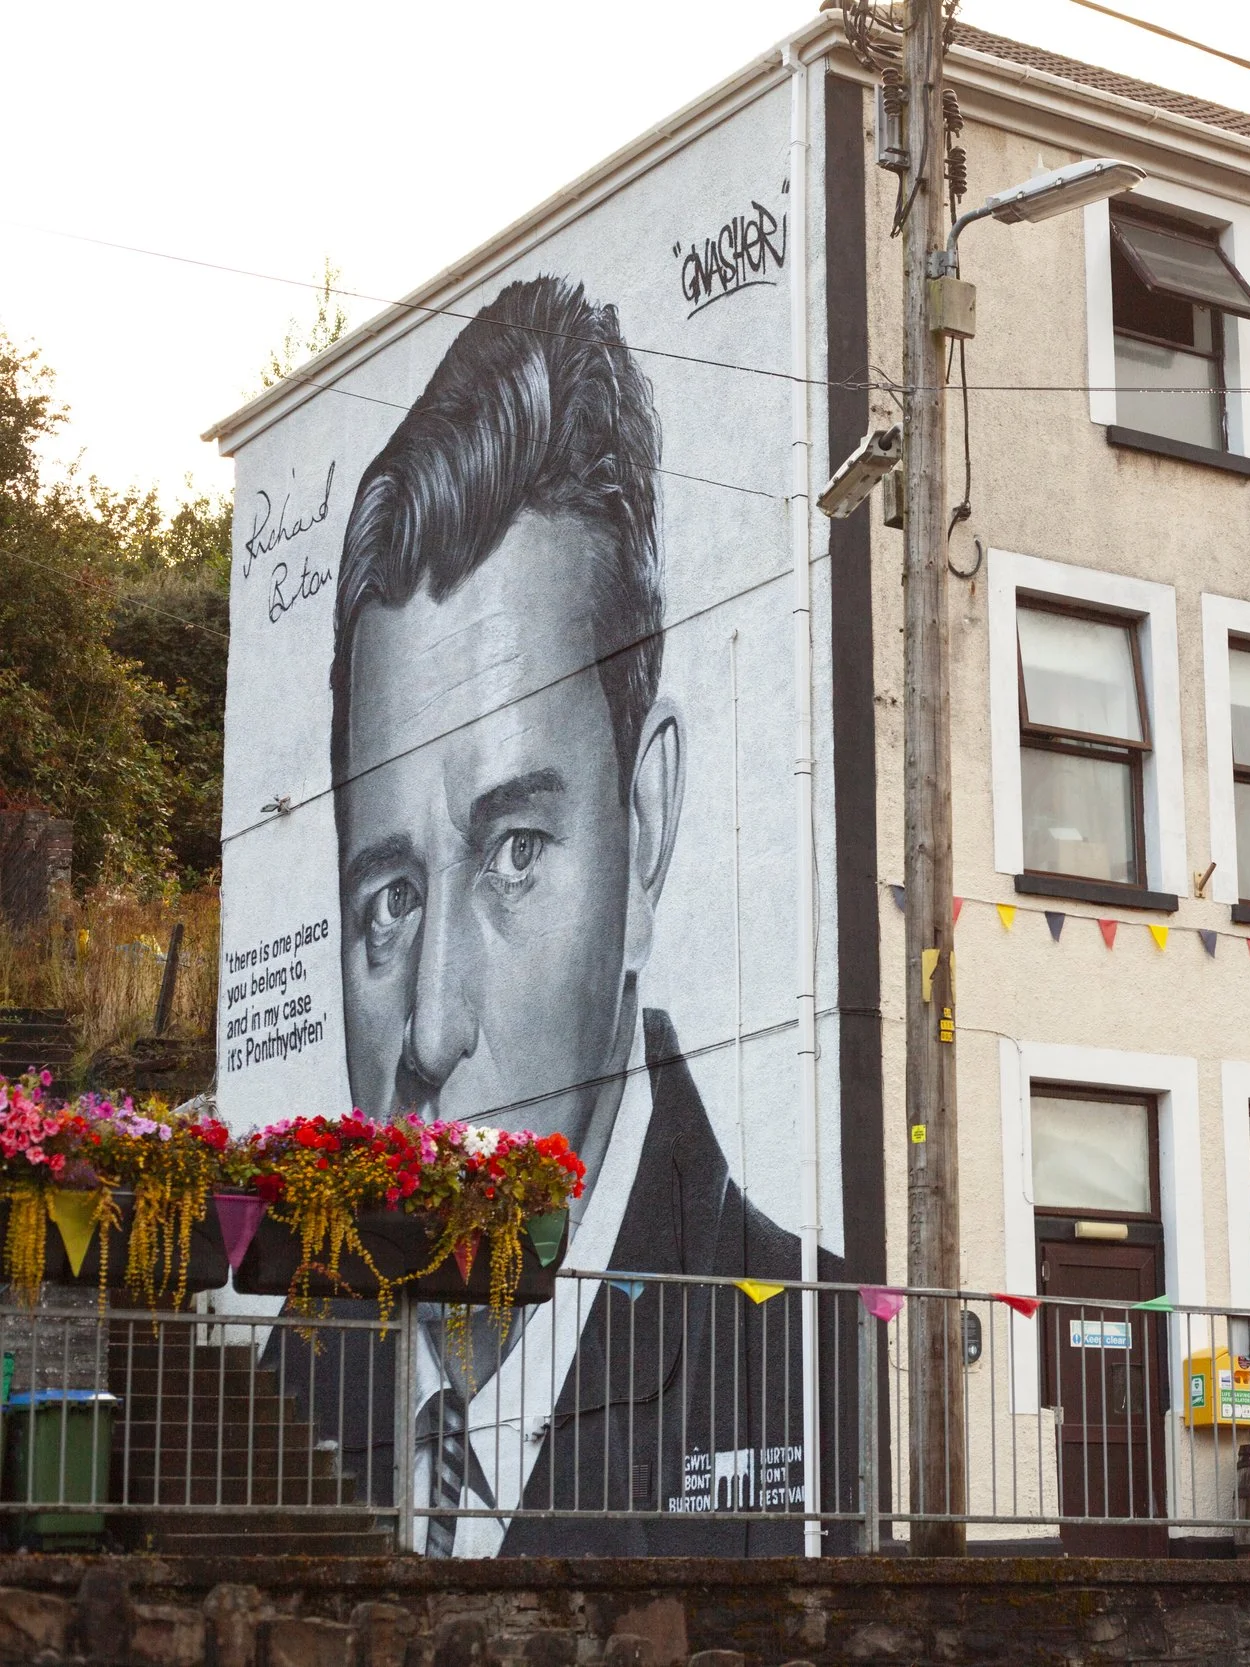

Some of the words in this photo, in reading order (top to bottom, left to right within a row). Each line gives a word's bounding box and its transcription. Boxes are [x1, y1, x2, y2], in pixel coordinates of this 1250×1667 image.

[259, 940, 270, 962] is
[272, 934, 292, 958] one
[294, 918, 329, 957] place
[227, 982, 247, 1009] you
[250, 966, 287, 996] belong
[290, 960, 307, 981] to,
[227, 1008, 248, 1040] and
[251, 1005, 261, 1030] in
[264, 1003, 280, 1027] my
[283, 994, 312, 1020] case
[227, 1046, 243, 1072] it's
[1106, 1335, 1126, 1345] clear
[684, 1474, 711, 1491] BONT
[669, 1494, 711, 1512] BURTON
[760, 1485, 805, 1507] ESTVA
